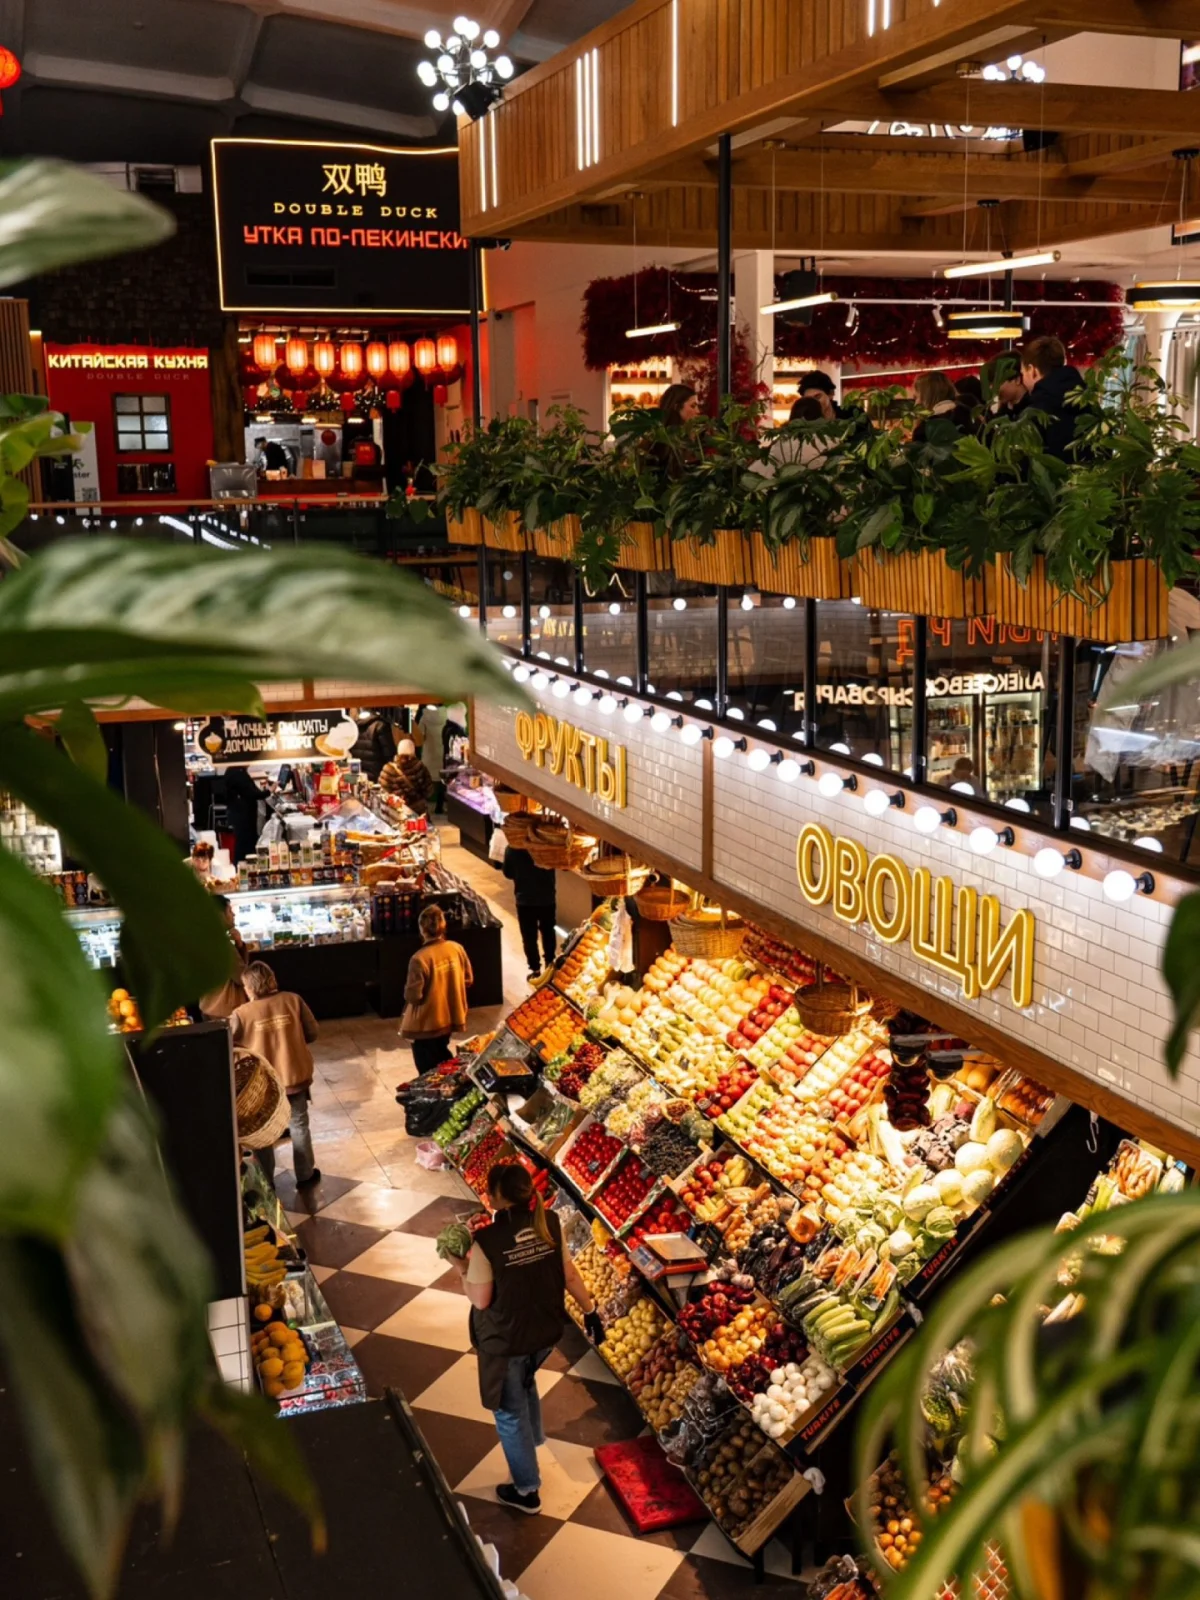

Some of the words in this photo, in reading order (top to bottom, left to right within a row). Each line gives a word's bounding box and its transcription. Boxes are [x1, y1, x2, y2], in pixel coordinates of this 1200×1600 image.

[321, 163, 387, 197] 双鸭
[274, 202, 364, 217] DOUBLE
[380, 206, 438, 218] DUCK
[243, 225, 303, 246] УТКА
[310, 227, 468, 249] ПО-ПЕКИНСКИ
[48, 352, 149, 369] КИТАЙСКАЯ
[154, 355, 209, 369] КУХНЯ
[86, 372, 144, 380] DOUBLE
[514, 711, 627, 809] ФРУКТЫ
[796, 822, 1034, 1008] ОВОЩИ
